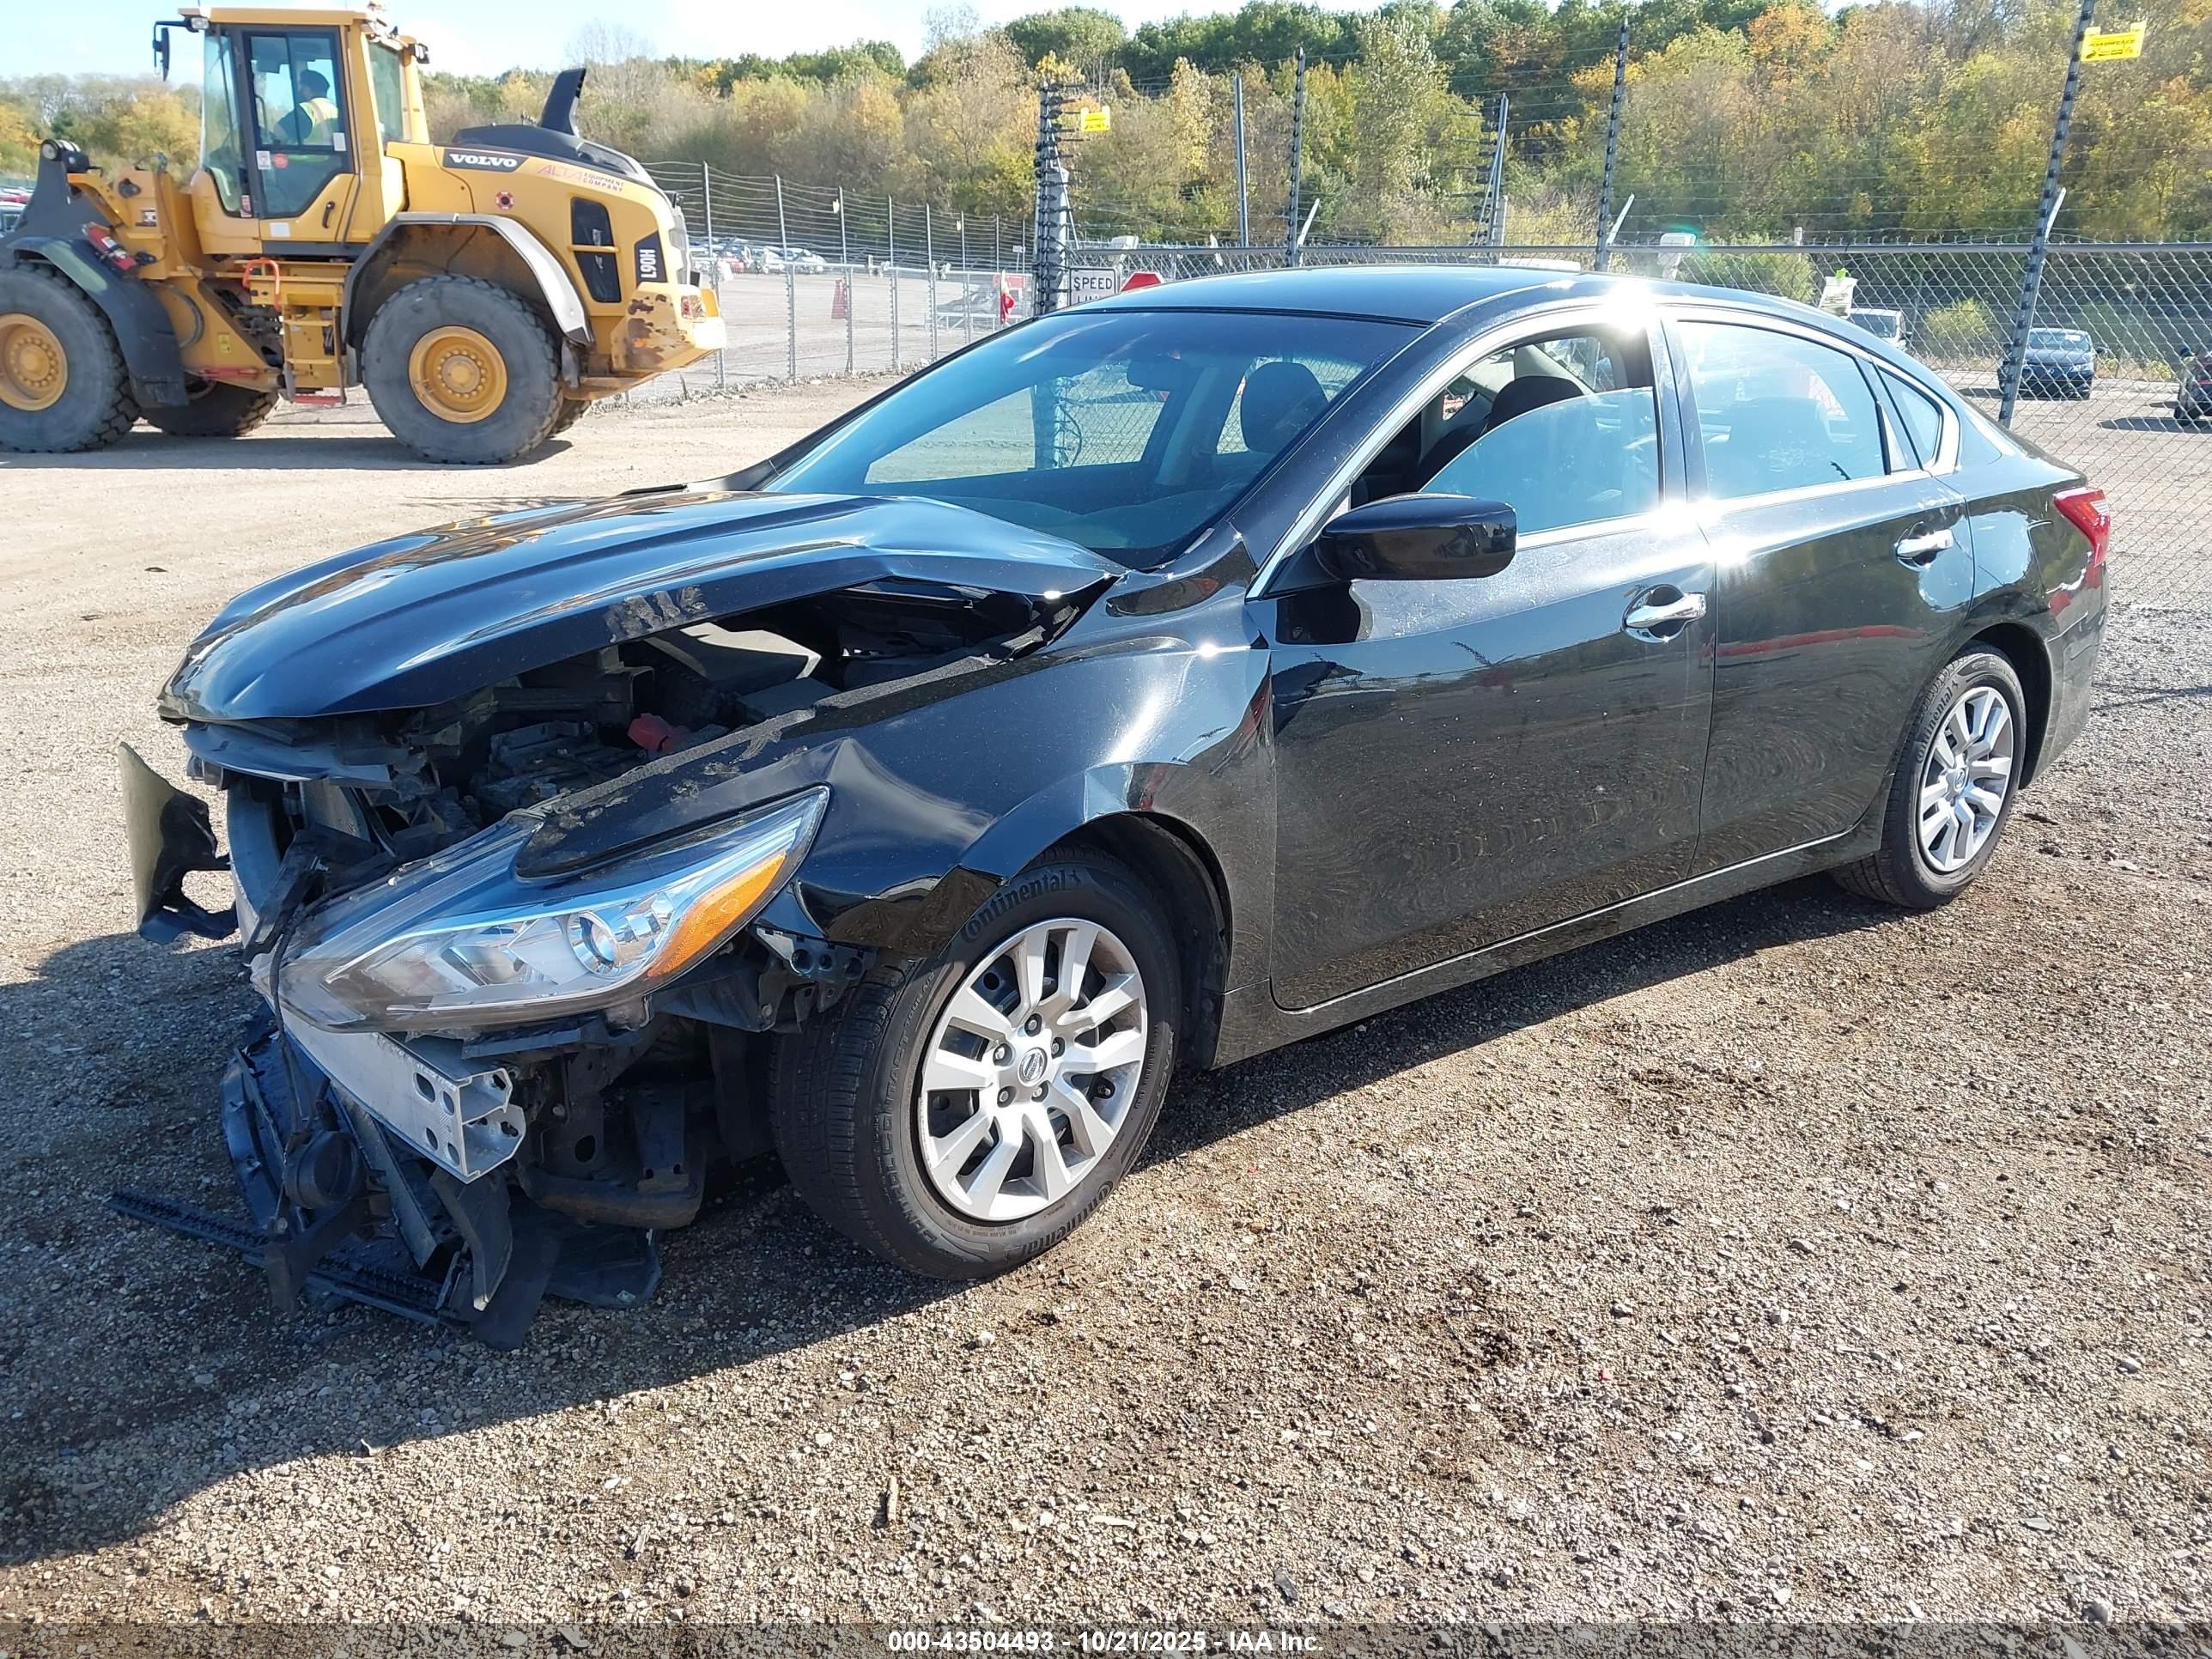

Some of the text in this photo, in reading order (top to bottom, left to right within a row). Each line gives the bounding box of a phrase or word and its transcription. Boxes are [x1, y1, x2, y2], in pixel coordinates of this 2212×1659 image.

[449, 153, 518, 168] VOLVO
[537, 164, 583, 182] ALTA
[583, 172, 625, 188] EQUIPMENT
[583, 177, 623, 193] COMPANY
[638, 248, 658, 279] L90H
[1073, 276, 1114, 290] SPEED
